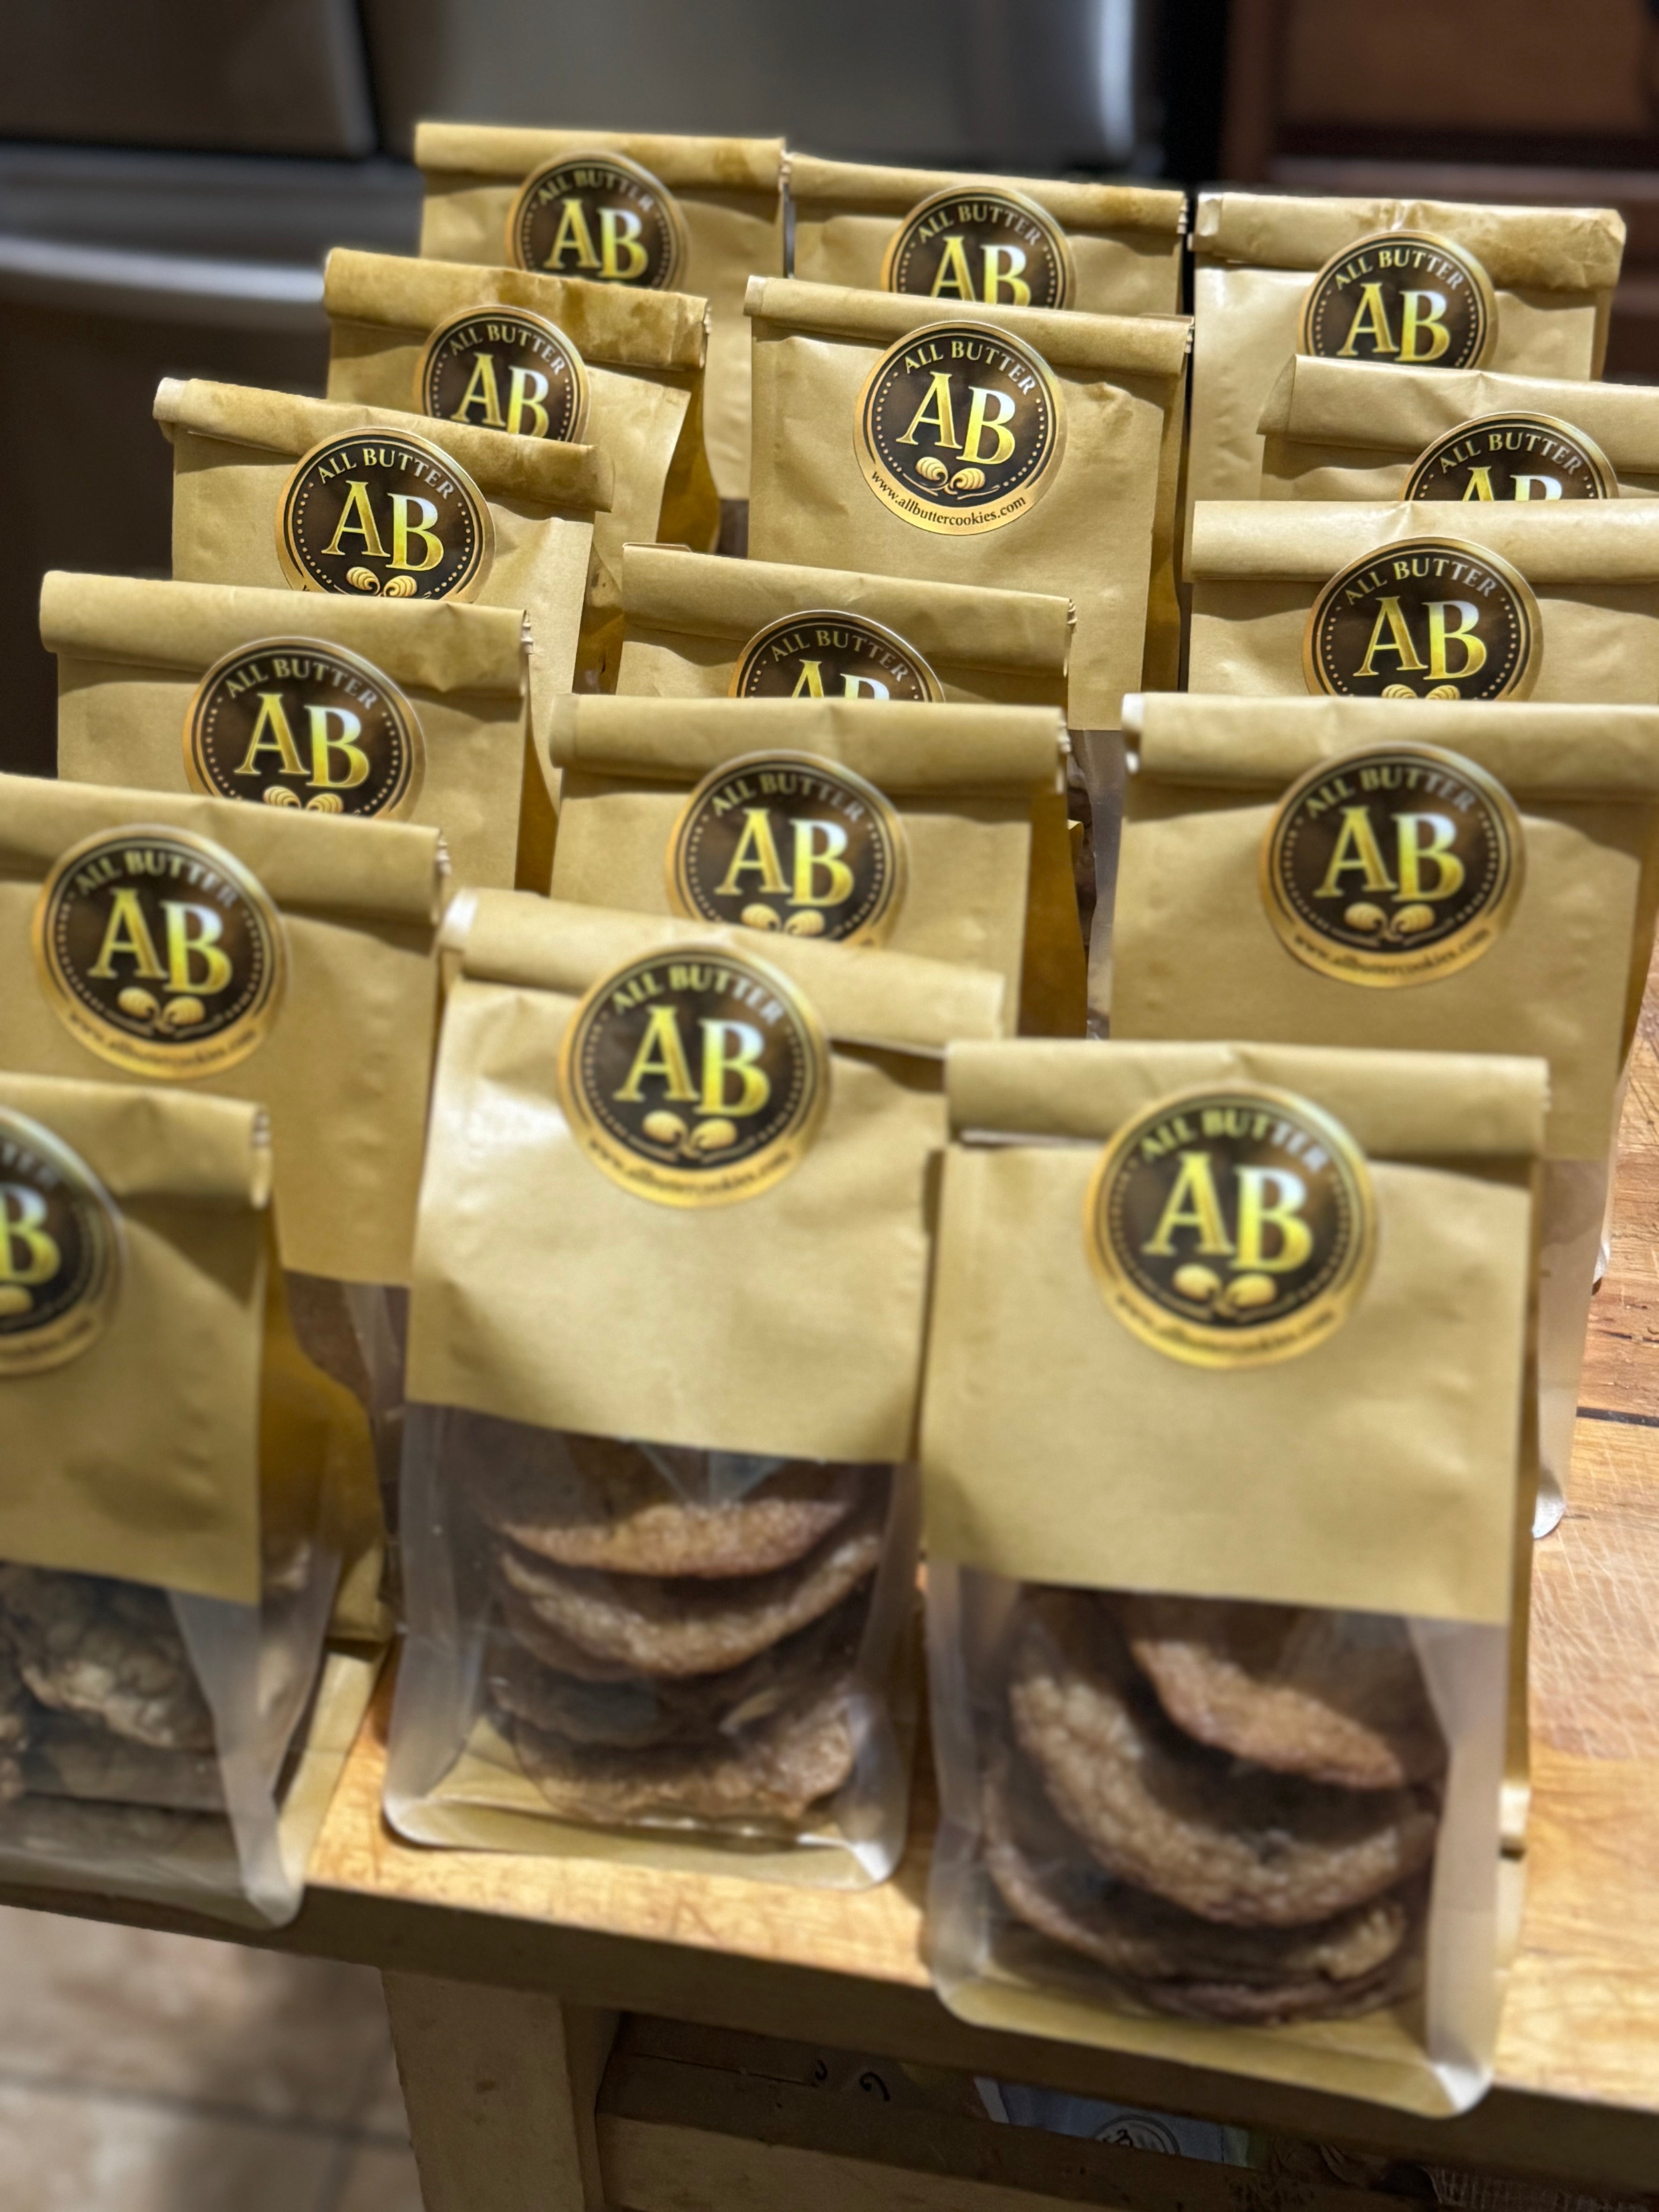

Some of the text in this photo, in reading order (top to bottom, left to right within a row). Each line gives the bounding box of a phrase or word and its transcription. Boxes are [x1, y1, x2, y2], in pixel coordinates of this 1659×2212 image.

[537, 172, 572, 205] ALL
[543, 198, 648, 279] AB
[916, 204, 1042, 246] ALL BUTTER
[931, 236, 1031, 307] AB
[1335, 248, 1465, 290] ALL BUTTER
[449, 324, 565, 375] ALL BUTTER
[1337, 283, 1450, 362] AB
[450, 353, 549, 437] AB
[904, 340, 1036, 395] ALL BUTTER
[896, 371, 1016, 465] AB
[318, 448, 454, 499] ALL BUTTER
[1440, 432, 1583, 475] ALL BUTTER
[321, 480, 444, 571] AB
[871, 471, 1026, 526] www.allbuttercookies.com
[1345, 558, 1497, 605] ALL BUTTER
[771, 630, 908, 682] ALL BUTTER
[1353, 596, 1487, 680] AB
[225, 658, 378, 710] ALL BUTTER
[234, 693, 369, 788] AB
[712, 780, 756, 817] ALL
[1304, 778, 1355, 818] ALL
[714, 808, 854, 906] AB
[1313, 806, 1465, 902] AB
[87, 888, 232, 995] AB
[612, 1005, 771, 1117] AB
[1141, 1150, 1313, 1272] AB
